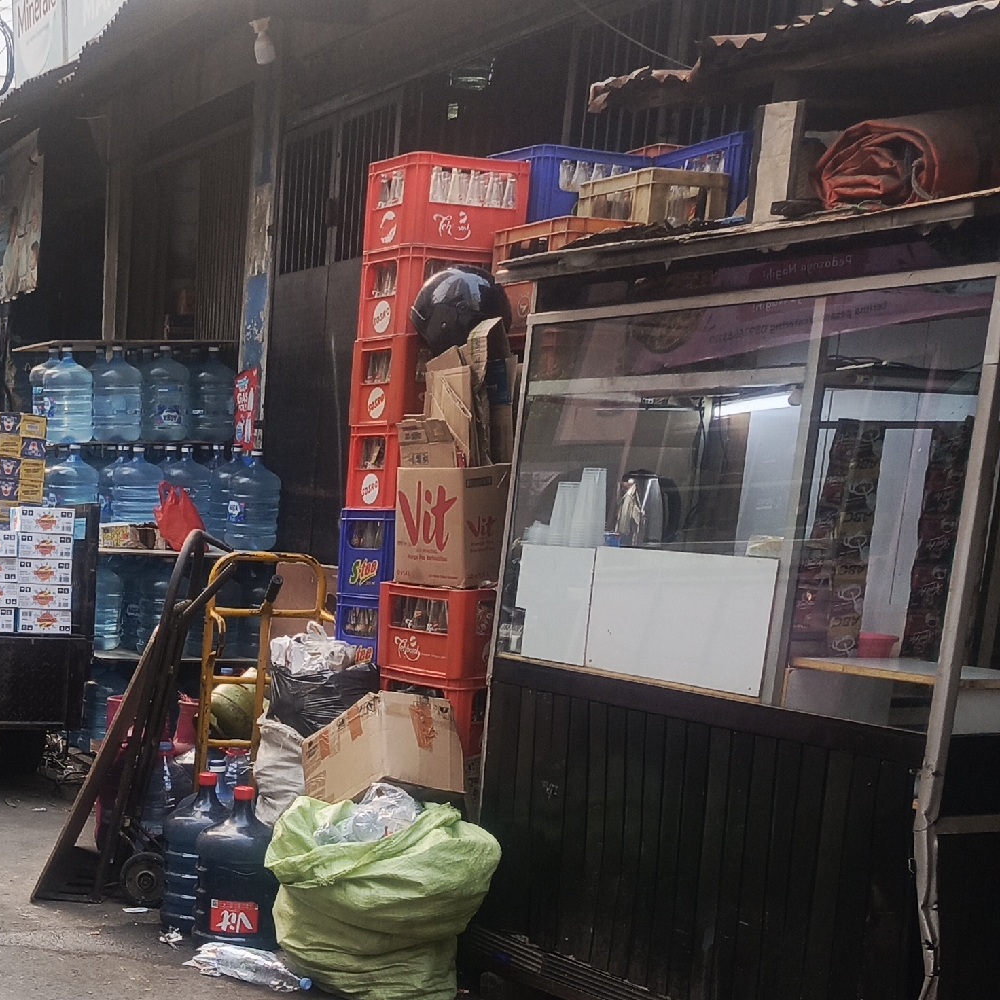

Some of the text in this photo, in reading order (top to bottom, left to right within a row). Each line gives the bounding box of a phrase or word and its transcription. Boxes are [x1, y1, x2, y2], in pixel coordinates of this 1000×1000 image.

[398, 480, 458, 552] Vit
[466, 515, 497, 538] Vit
[355, 644, 373, 665] tee
[216, 909, 253, 933] Vit
